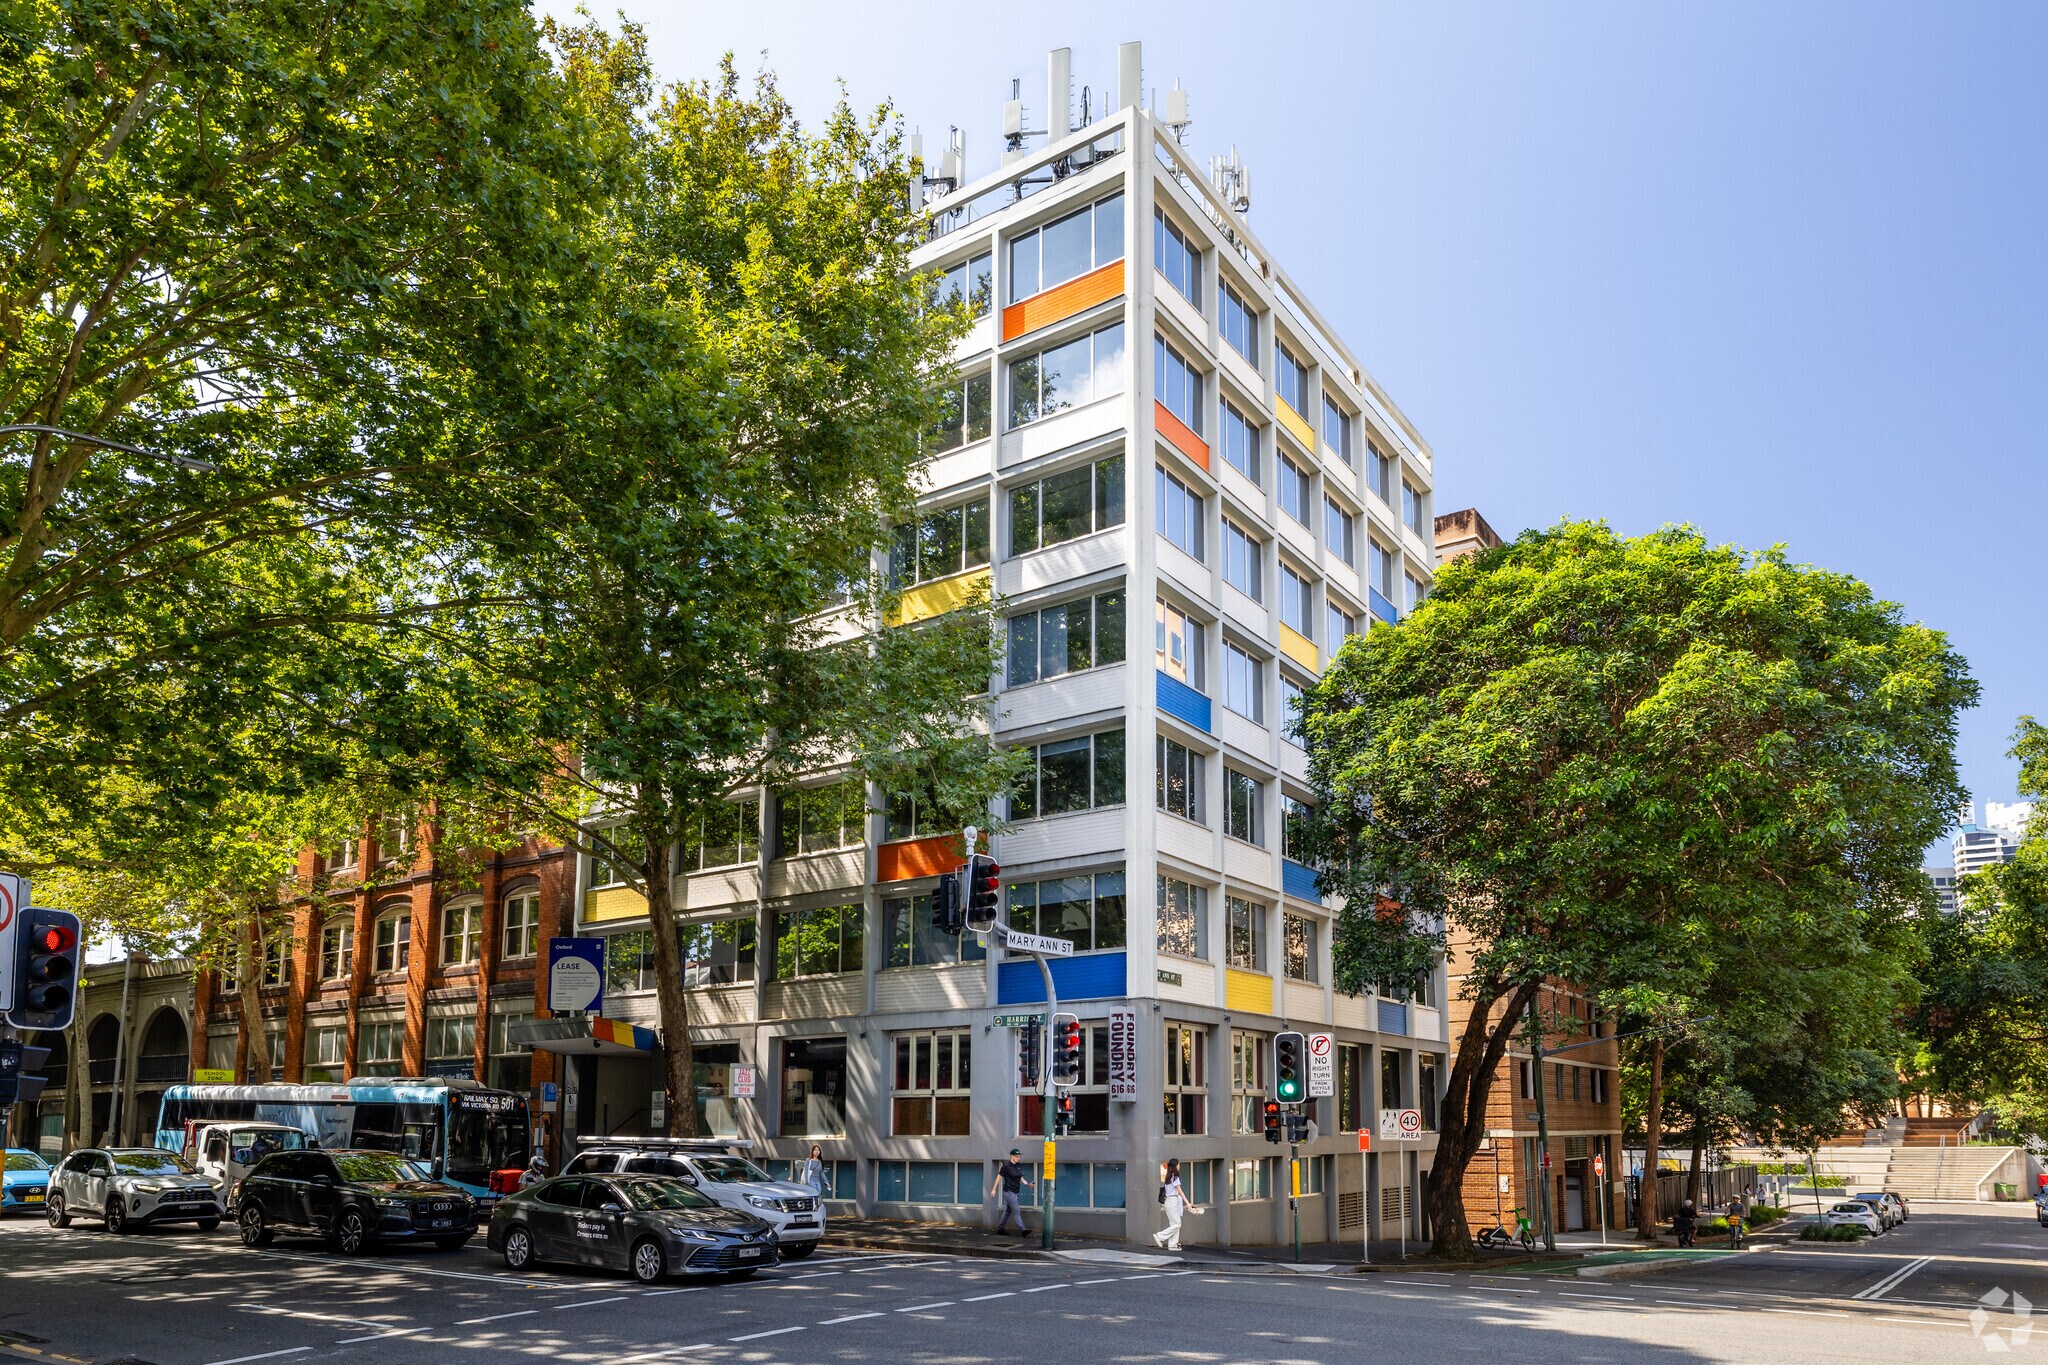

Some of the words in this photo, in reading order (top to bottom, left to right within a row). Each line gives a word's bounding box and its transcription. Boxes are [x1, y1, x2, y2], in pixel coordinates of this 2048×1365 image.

[1009, 934, 1035, 947] MARY
[1039, 939, 1058, 951] ANN
[1061, 942, 1072, 953] ST
[556, 962, 580, 970] LEASE
[1111, 1013, 1125, 1082] FOUNDRY
[1127, 1013, 1136, 1082] FOUNDRY
[1315, 1056, 1327, 1065] NO
[1111, 1084, 1125, 1094] 616
[1127, 1084, 1136, 1094] 616
[463, 1095, 488, 1103] RAILWAY
[500, 1098, 515, 1110] 501
[1403, 1116, 1418, 1126] 40
[577, 1230, 592, 1238] Drivers
